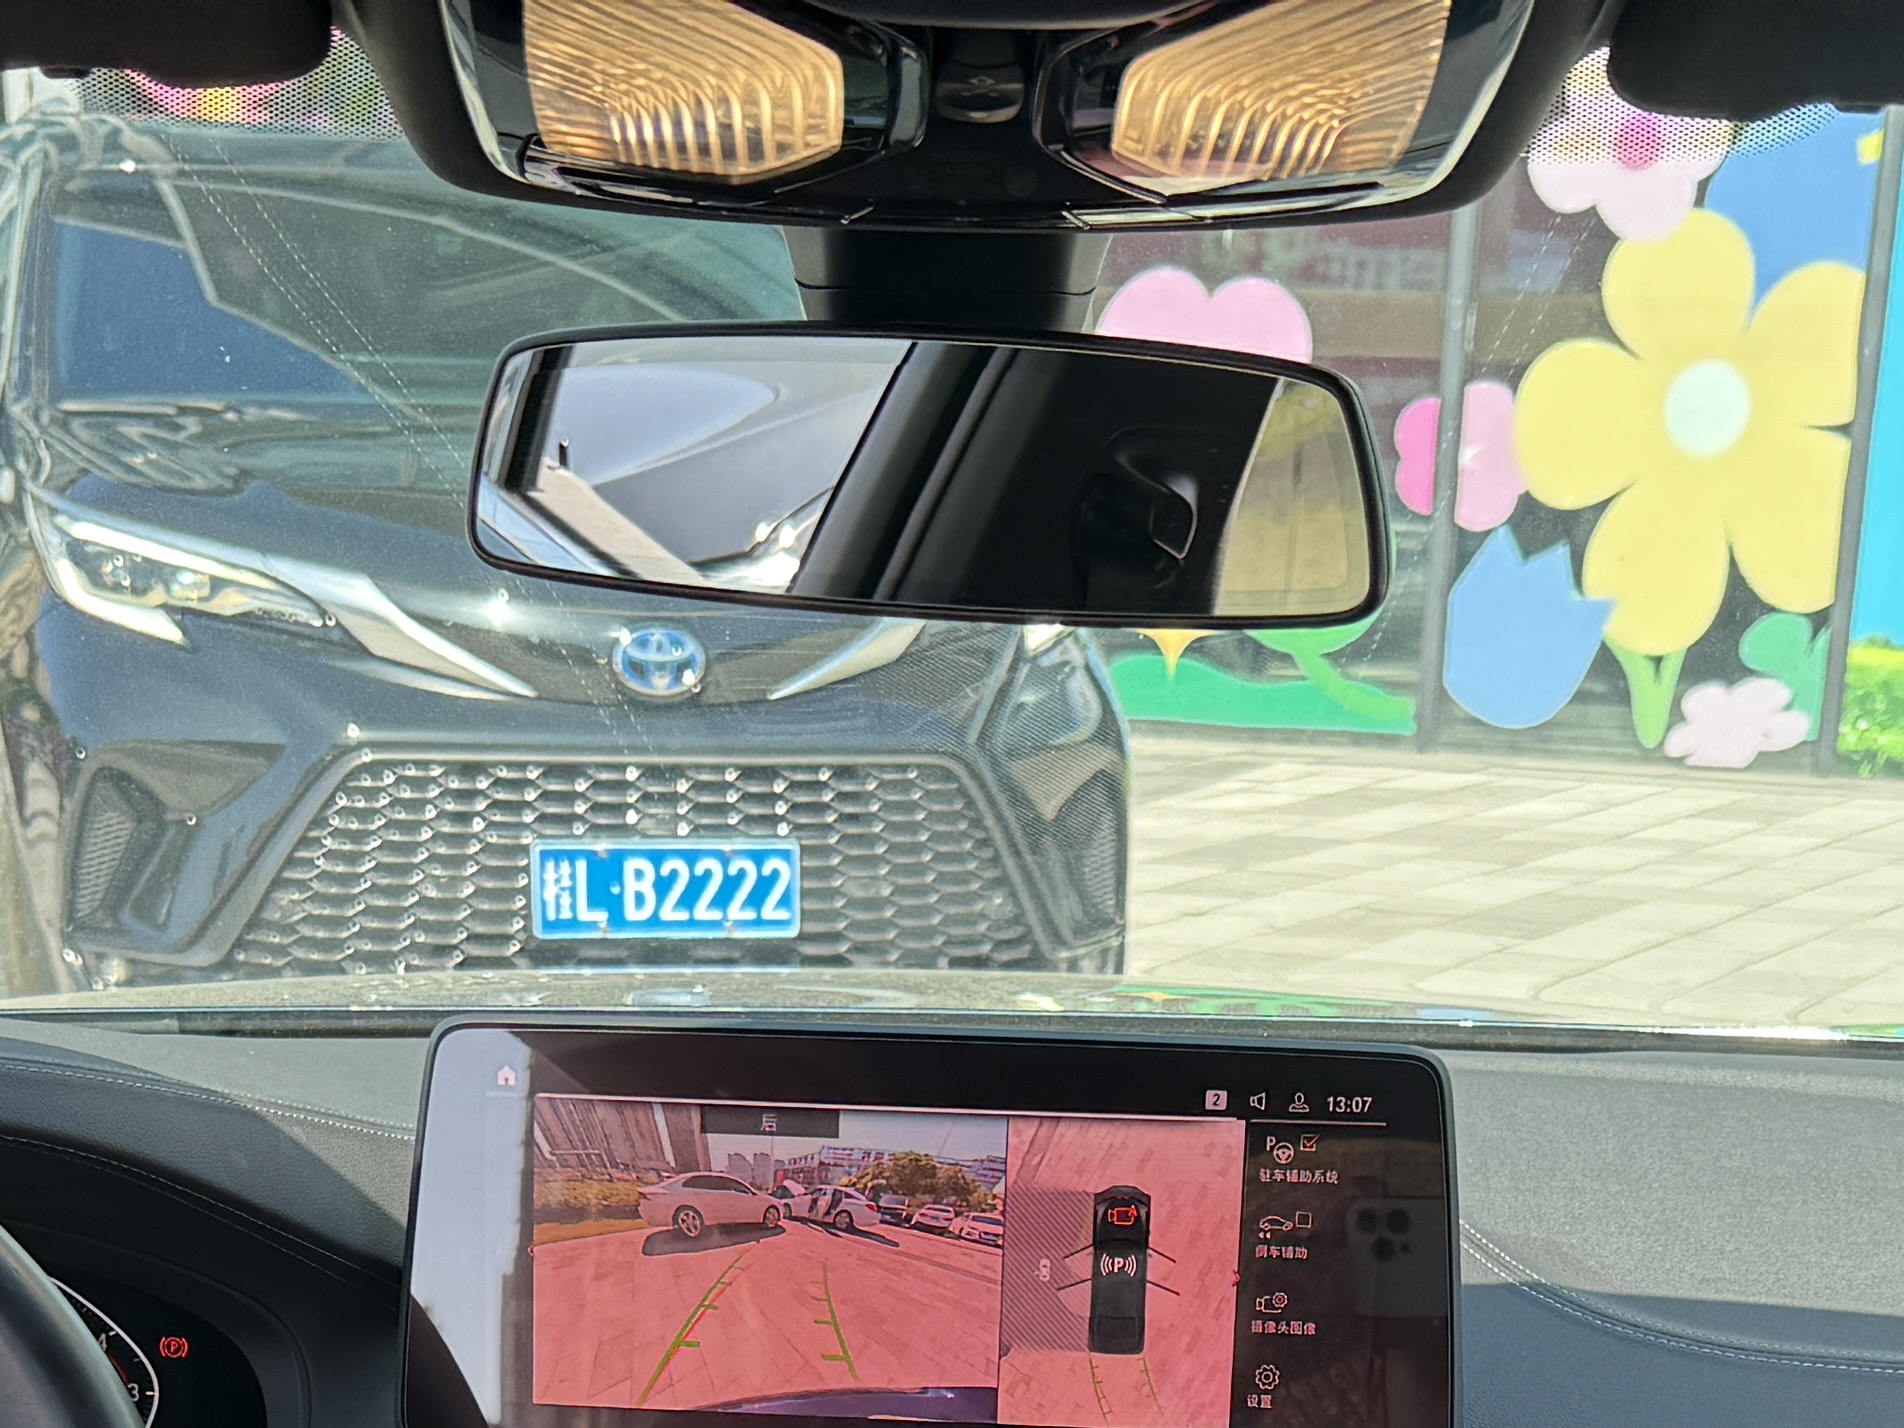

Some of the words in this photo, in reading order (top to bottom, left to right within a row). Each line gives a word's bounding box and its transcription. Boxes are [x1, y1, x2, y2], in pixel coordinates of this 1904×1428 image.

[1325, 1096, 1373, 1114] 13:07
[1259, 1168, 1339, 1185] 驻车辅助系统
[1255, 1244, 1309, 1260] 倒车辅助
[1251, 1320, 1317, 1336] 摄像头图像
[1247, 1395, 1273, 1410] 设置
